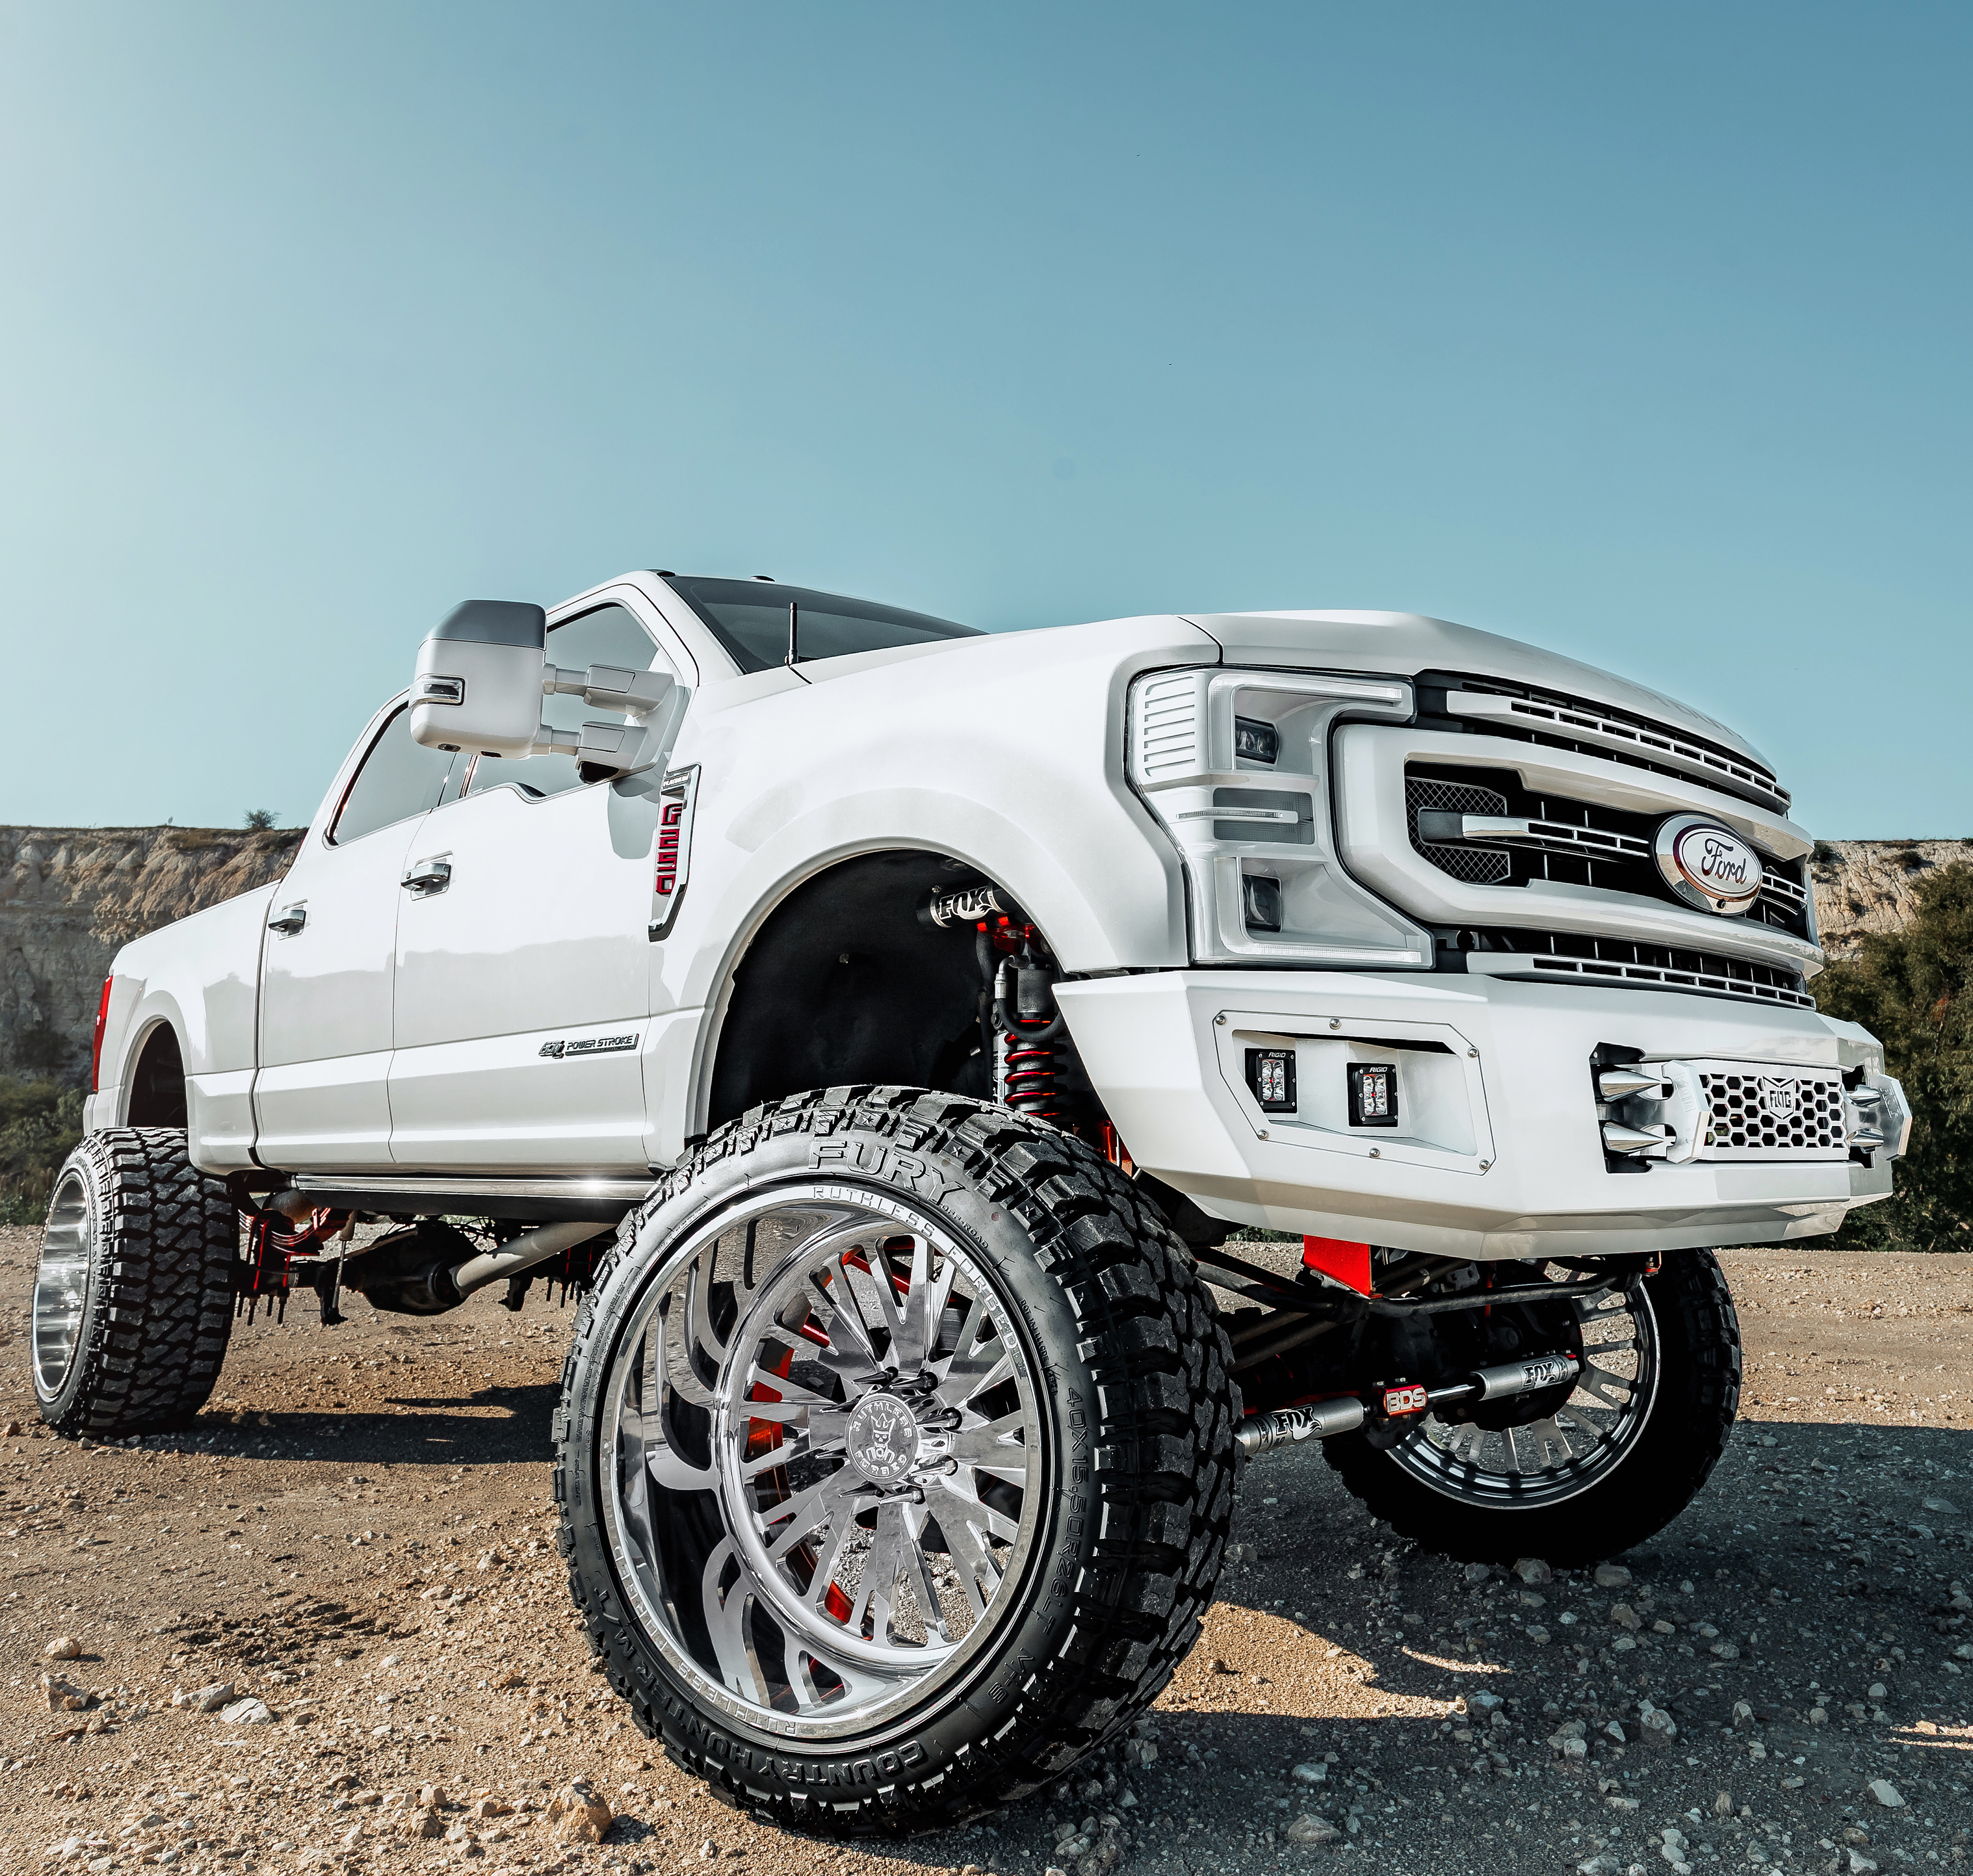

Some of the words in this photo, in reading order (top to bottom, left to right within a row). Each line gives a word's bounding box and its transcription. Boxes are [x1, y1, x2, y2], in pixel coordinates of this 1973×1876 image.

[663, 775, 688, 787] PLATINUM
[1702, 838, 1747, 885] Ford
[938, 886, 993, 920] FOX
[566, 1039, 596, 1050] POWER
[597, 1036, 633, 1047] STROKE
[808, 1141, 966, 1206] FURY
[813, 1187, 935, 1238] RUTHLESS
[948, 1245, 1017, 1349] FORGED
[1019, 1299, 1032, 1314] DOT
[1522, 1361, 1557, 1389] FOX
[1386, 1388, 1426, 1413] BDS
[1272, 1405, 1323, 1441] FOX
[593, 1587, 637, 1660] M/T
[635, 1661, 753, 1770] HUNTER
[676, 1662, 796, 1737] RUTHLESS
[759, 1740, 924, 1786] COUNTRY
